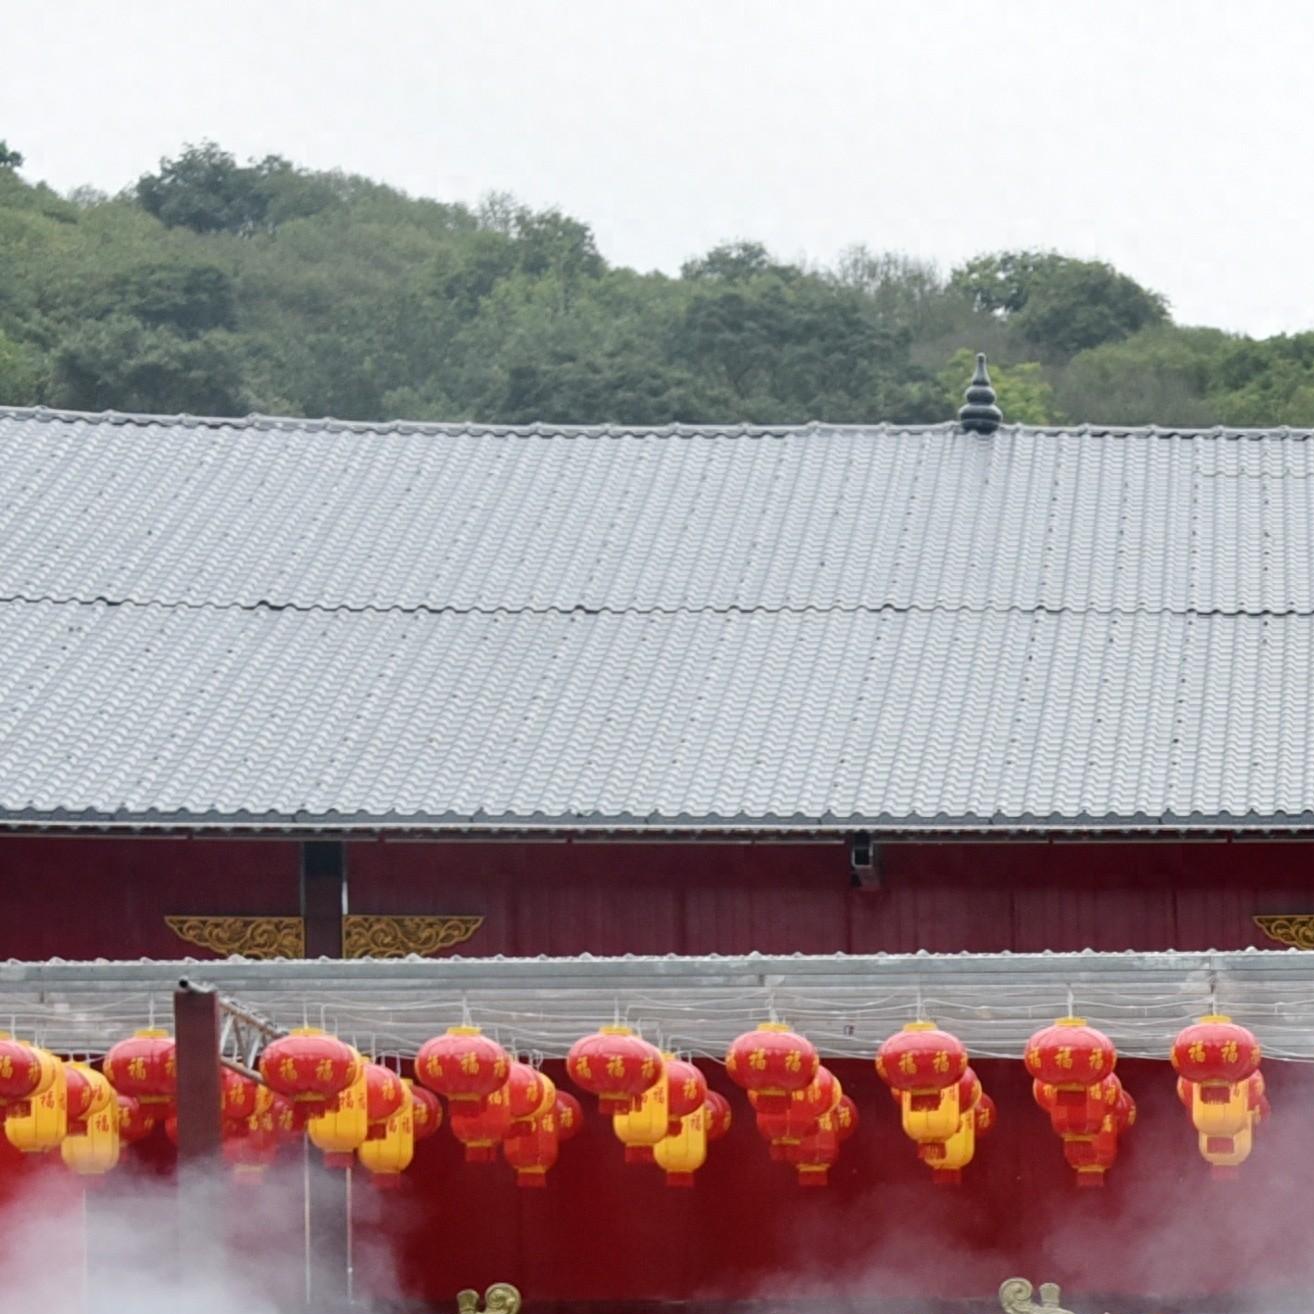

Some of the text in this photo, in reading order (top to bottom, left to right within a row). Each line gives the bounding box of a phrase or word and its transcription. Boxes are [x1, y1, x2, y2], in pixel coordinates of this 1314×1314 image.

[749, 1048, 767, 1070] 福
[785, 1049, 801, 1072] 福
[932, 1051, 950, 1073] 福
[1028, 1049, 1041, 1070] 福
[1055, 1047, 1073, 1069] 福
[1090, 1048, 1104, 1070] 福
[1189, 1040, 1206, 1063] 福
[1221, 1040, 1238, 1063] 福
[127, 1057, 146, 1080] 福
[280, 1057, 298, 1080] 福
[316, 1058, 333, 1080] 福
[425, 1055, 443, 1077] 福
[461, 1052, 480, 1074] 福
[494, 1056, 506, 1077] 福
[576, 1056, 592, 1078] 福
[607, 1055, 625, 1078] 福
[641, 1056, 655, 1079] 福
[899, 1053, 917, 1075] 福
[40, 1091, 55, 1109] 福
[232, 1083, 245, 1104] 福
[381, 1079, 395, 1100] 福
[526, 1080, 540, 1102] 福
[683, 1078, 697, 1100] 福
[807, 1079, 821, 1103] 福
[96, 1114, 109, 1133] 福
[280, 1108, 293, 1129] 福
[414, 1103, 428, 1123] 福
[542, 1113, 555, 1132] 福
[560, 1106, 574, 1127] 福
[818, 1111, 832, 1131] 福
[840, 1107, 851, 1128] 福
[979, 1108, 991, 1128] 福
